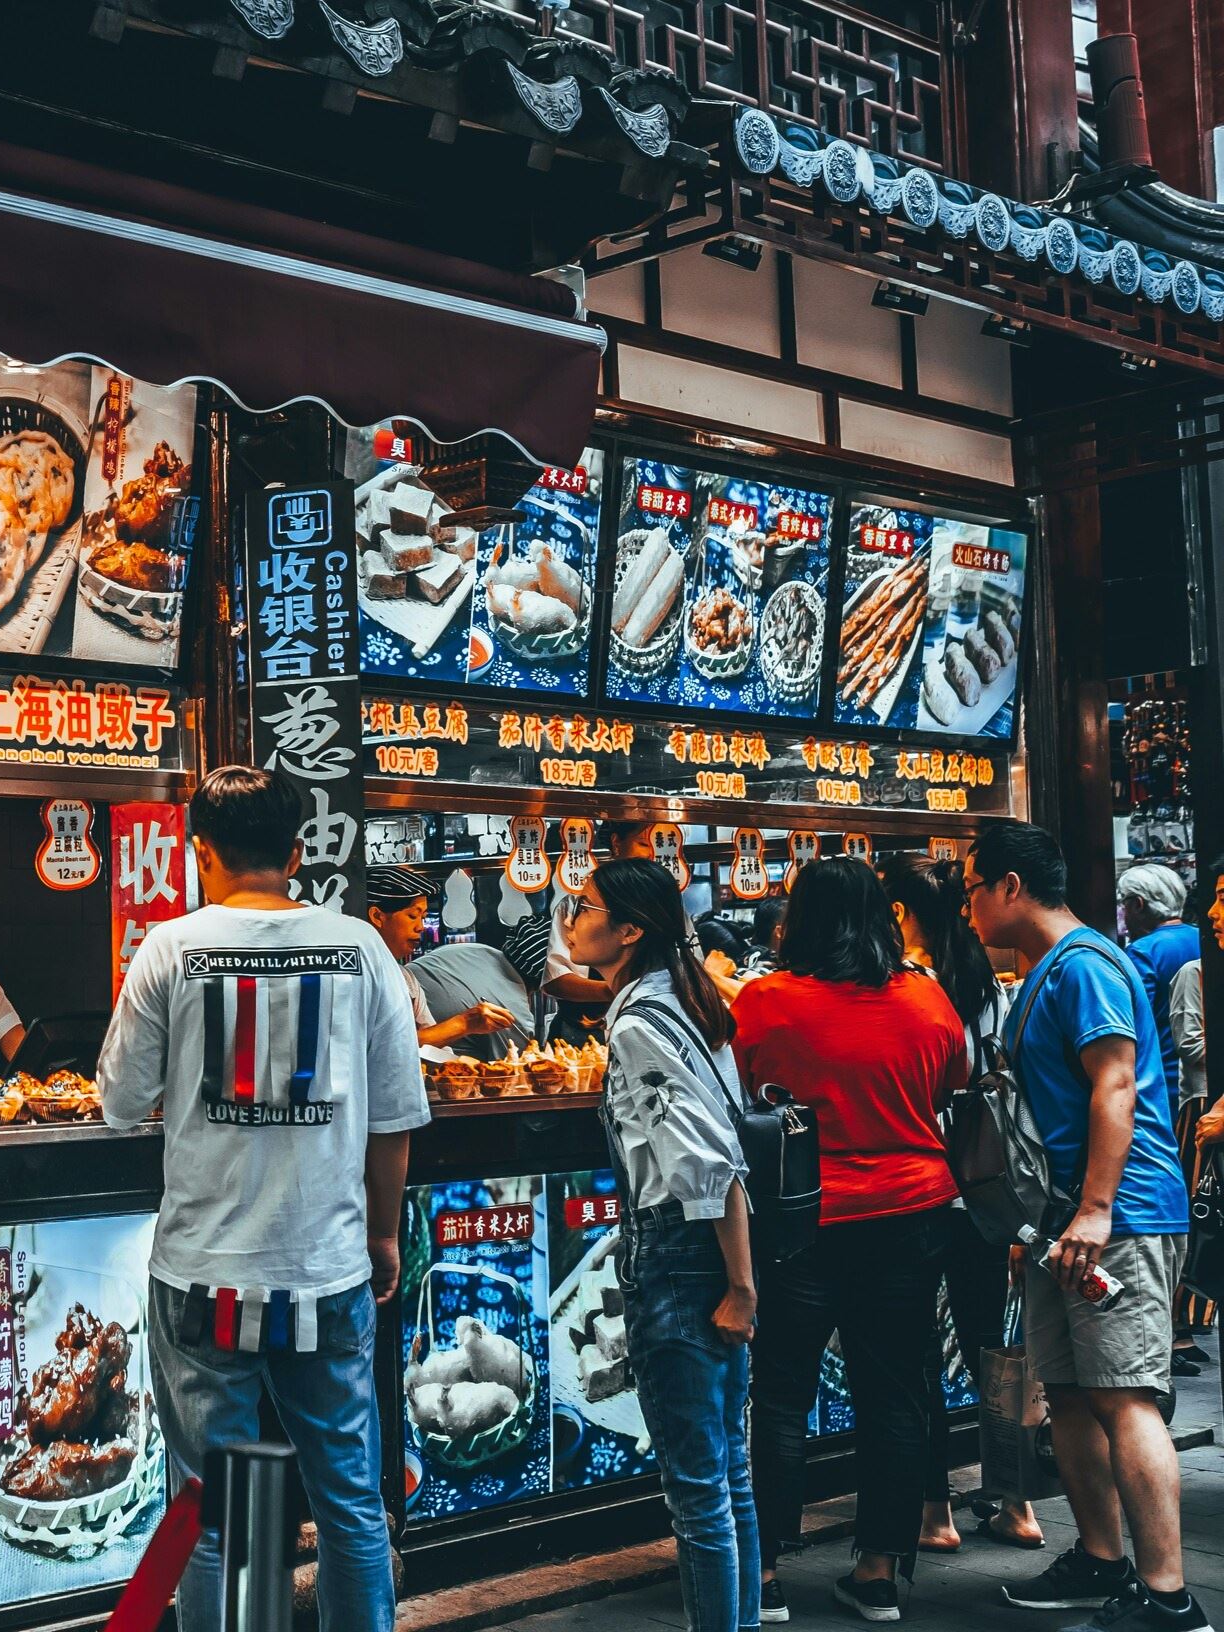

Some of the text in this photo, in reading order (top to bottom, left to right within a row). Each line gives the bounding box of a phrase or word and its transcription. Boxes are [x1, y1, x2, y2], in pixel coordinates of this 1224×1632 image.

[538, 468, 584, 491] 米大虾
[257, 551, 319, 679] 收银台
[324, 550, 352, 674] Cashier
[499, 711, 634, 755] 茄汁香米大虾
[67, 750, 160, 768] youdunzi
[376, 746, 439, 775] 10元/客
[669, 730, 771, 770] 香脆玉米棒
[802, 737, 874, 779] 香酥里脊
[540, 758, 596, 786] 18元/客
[696, 772, 746, 798] 10元/根
[816, 779, 861, 804] 10元/串
[926, 788, 968, 811] 15元/串
[57, 868, 86, 879] 12元/客
[207, 1102, 249, 1122] LOVE
[294, 1105, 333, 1124] LOVE
[442, 1212, 529, 1241] 茄汁香米大虾
[18, 1301, 28, 1362] Lemon
